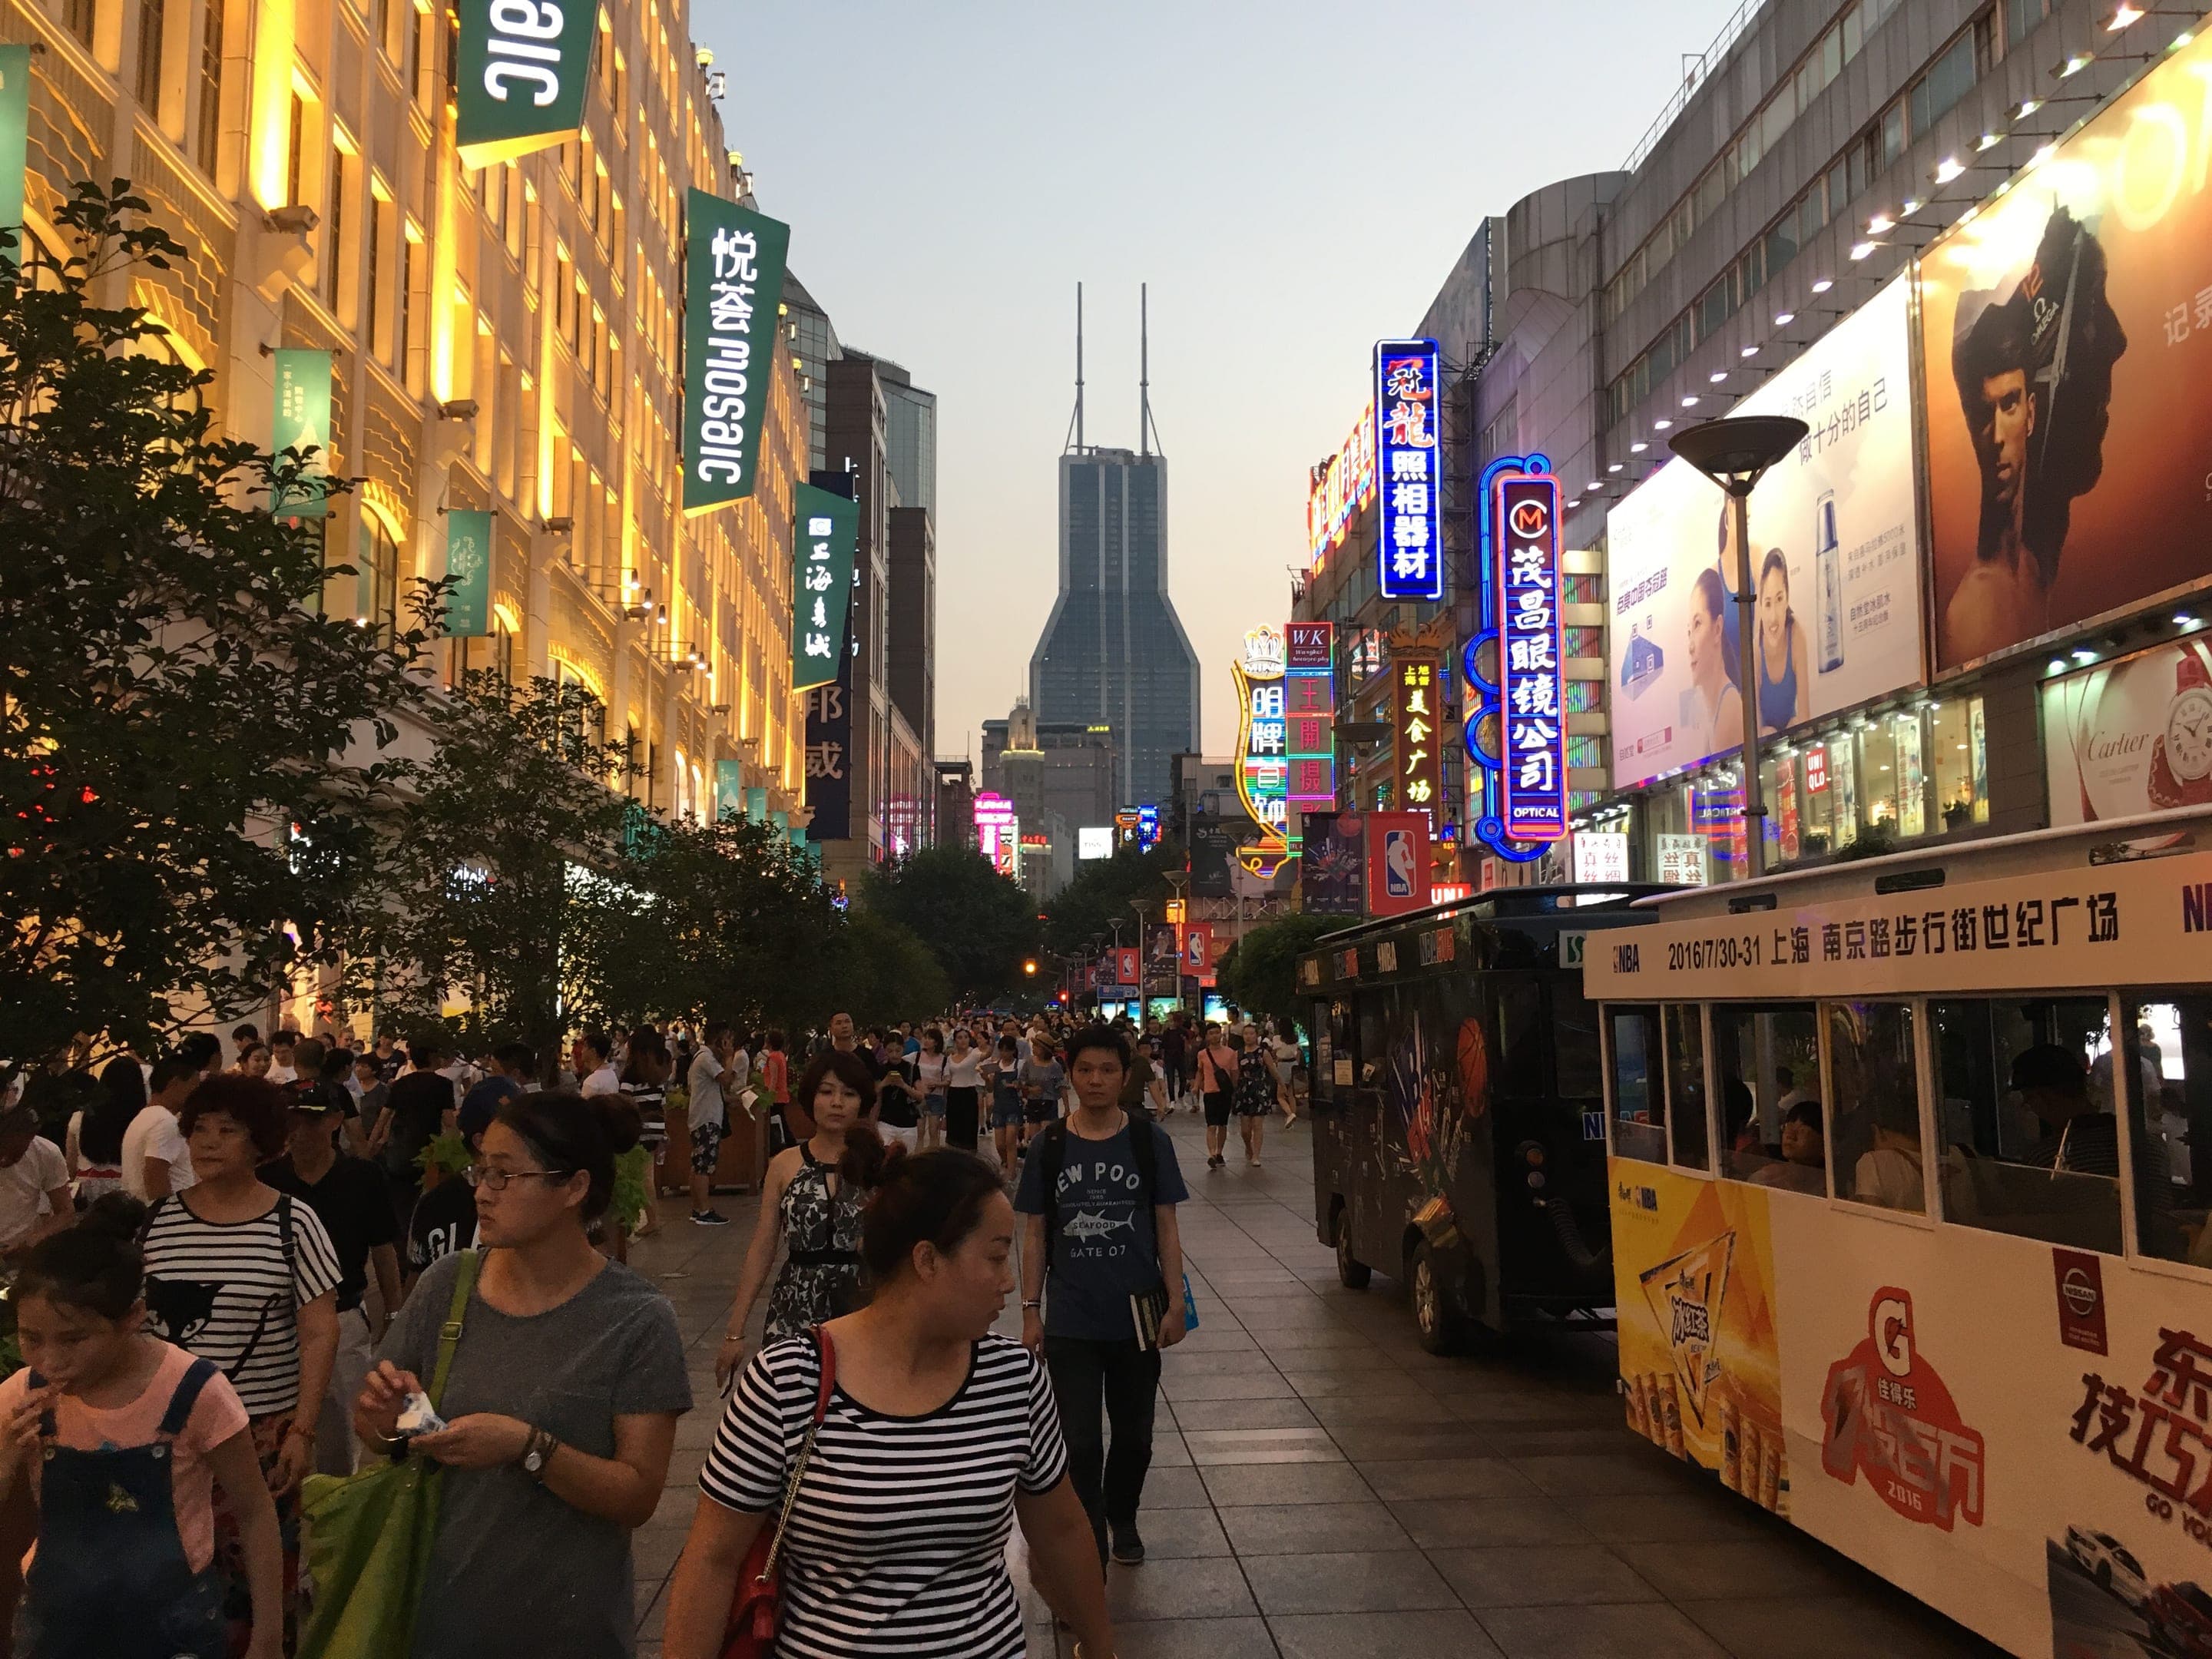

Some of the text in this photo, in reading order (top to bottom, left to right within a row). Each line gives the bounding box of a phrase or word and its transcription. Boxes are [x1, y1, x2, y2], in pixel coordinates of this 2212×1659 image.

[698, 227, 757, 485] 悦荟 mosaic
[1799, 376, 1888, 466] 做十分的自己
[1511, 545, 1558, 792] 茂昌眼镜公司
[1404, 688, 1432, 803] 美食广场
[1807, 753, 1823, 770] UNI
[2088, 730, 2150, 763] Cartier
[1808, 771, 1825, 790] QLO
[1513, 807, 1559, 819] OPTICAL
[1390, 883, 1407, 892] NBA
[1667, 892, 2120, 971] 2016/7/30-31 上海 南京路步行街世纪广场
[1618, 943, 1640, 973] NBA
[1070, 1244, 1126, 1258] GATE 07
[2064, 1285, 2095, 1300] NISSAN
[1874, 1298, 1912, 1376] G
[1876, 1376, 1918, 1410] 佳得乐
[1887, 1480, 1922, 1512] 2016
[2145, 1492, 2173, 1519] GO
